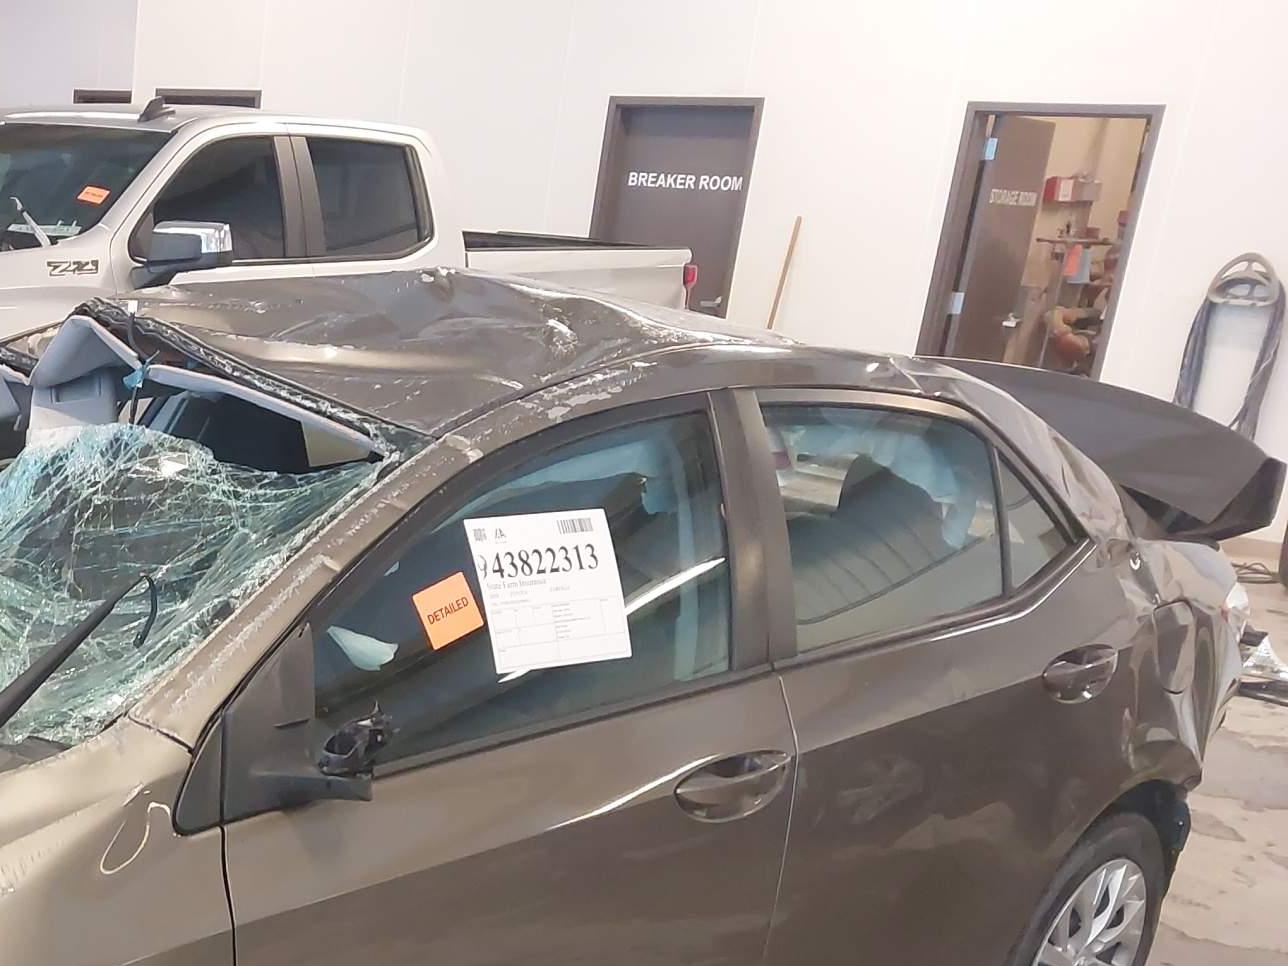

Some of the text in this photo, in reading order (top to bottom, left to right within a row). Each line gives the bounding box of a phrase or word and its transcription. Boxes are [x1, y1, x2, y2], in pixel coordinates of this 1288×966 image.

[628, 171, 743, 191] BREAKER ROOM
[492, 543, 599, 579] 43822313
[427, 596, 469, 625] DETAILED
